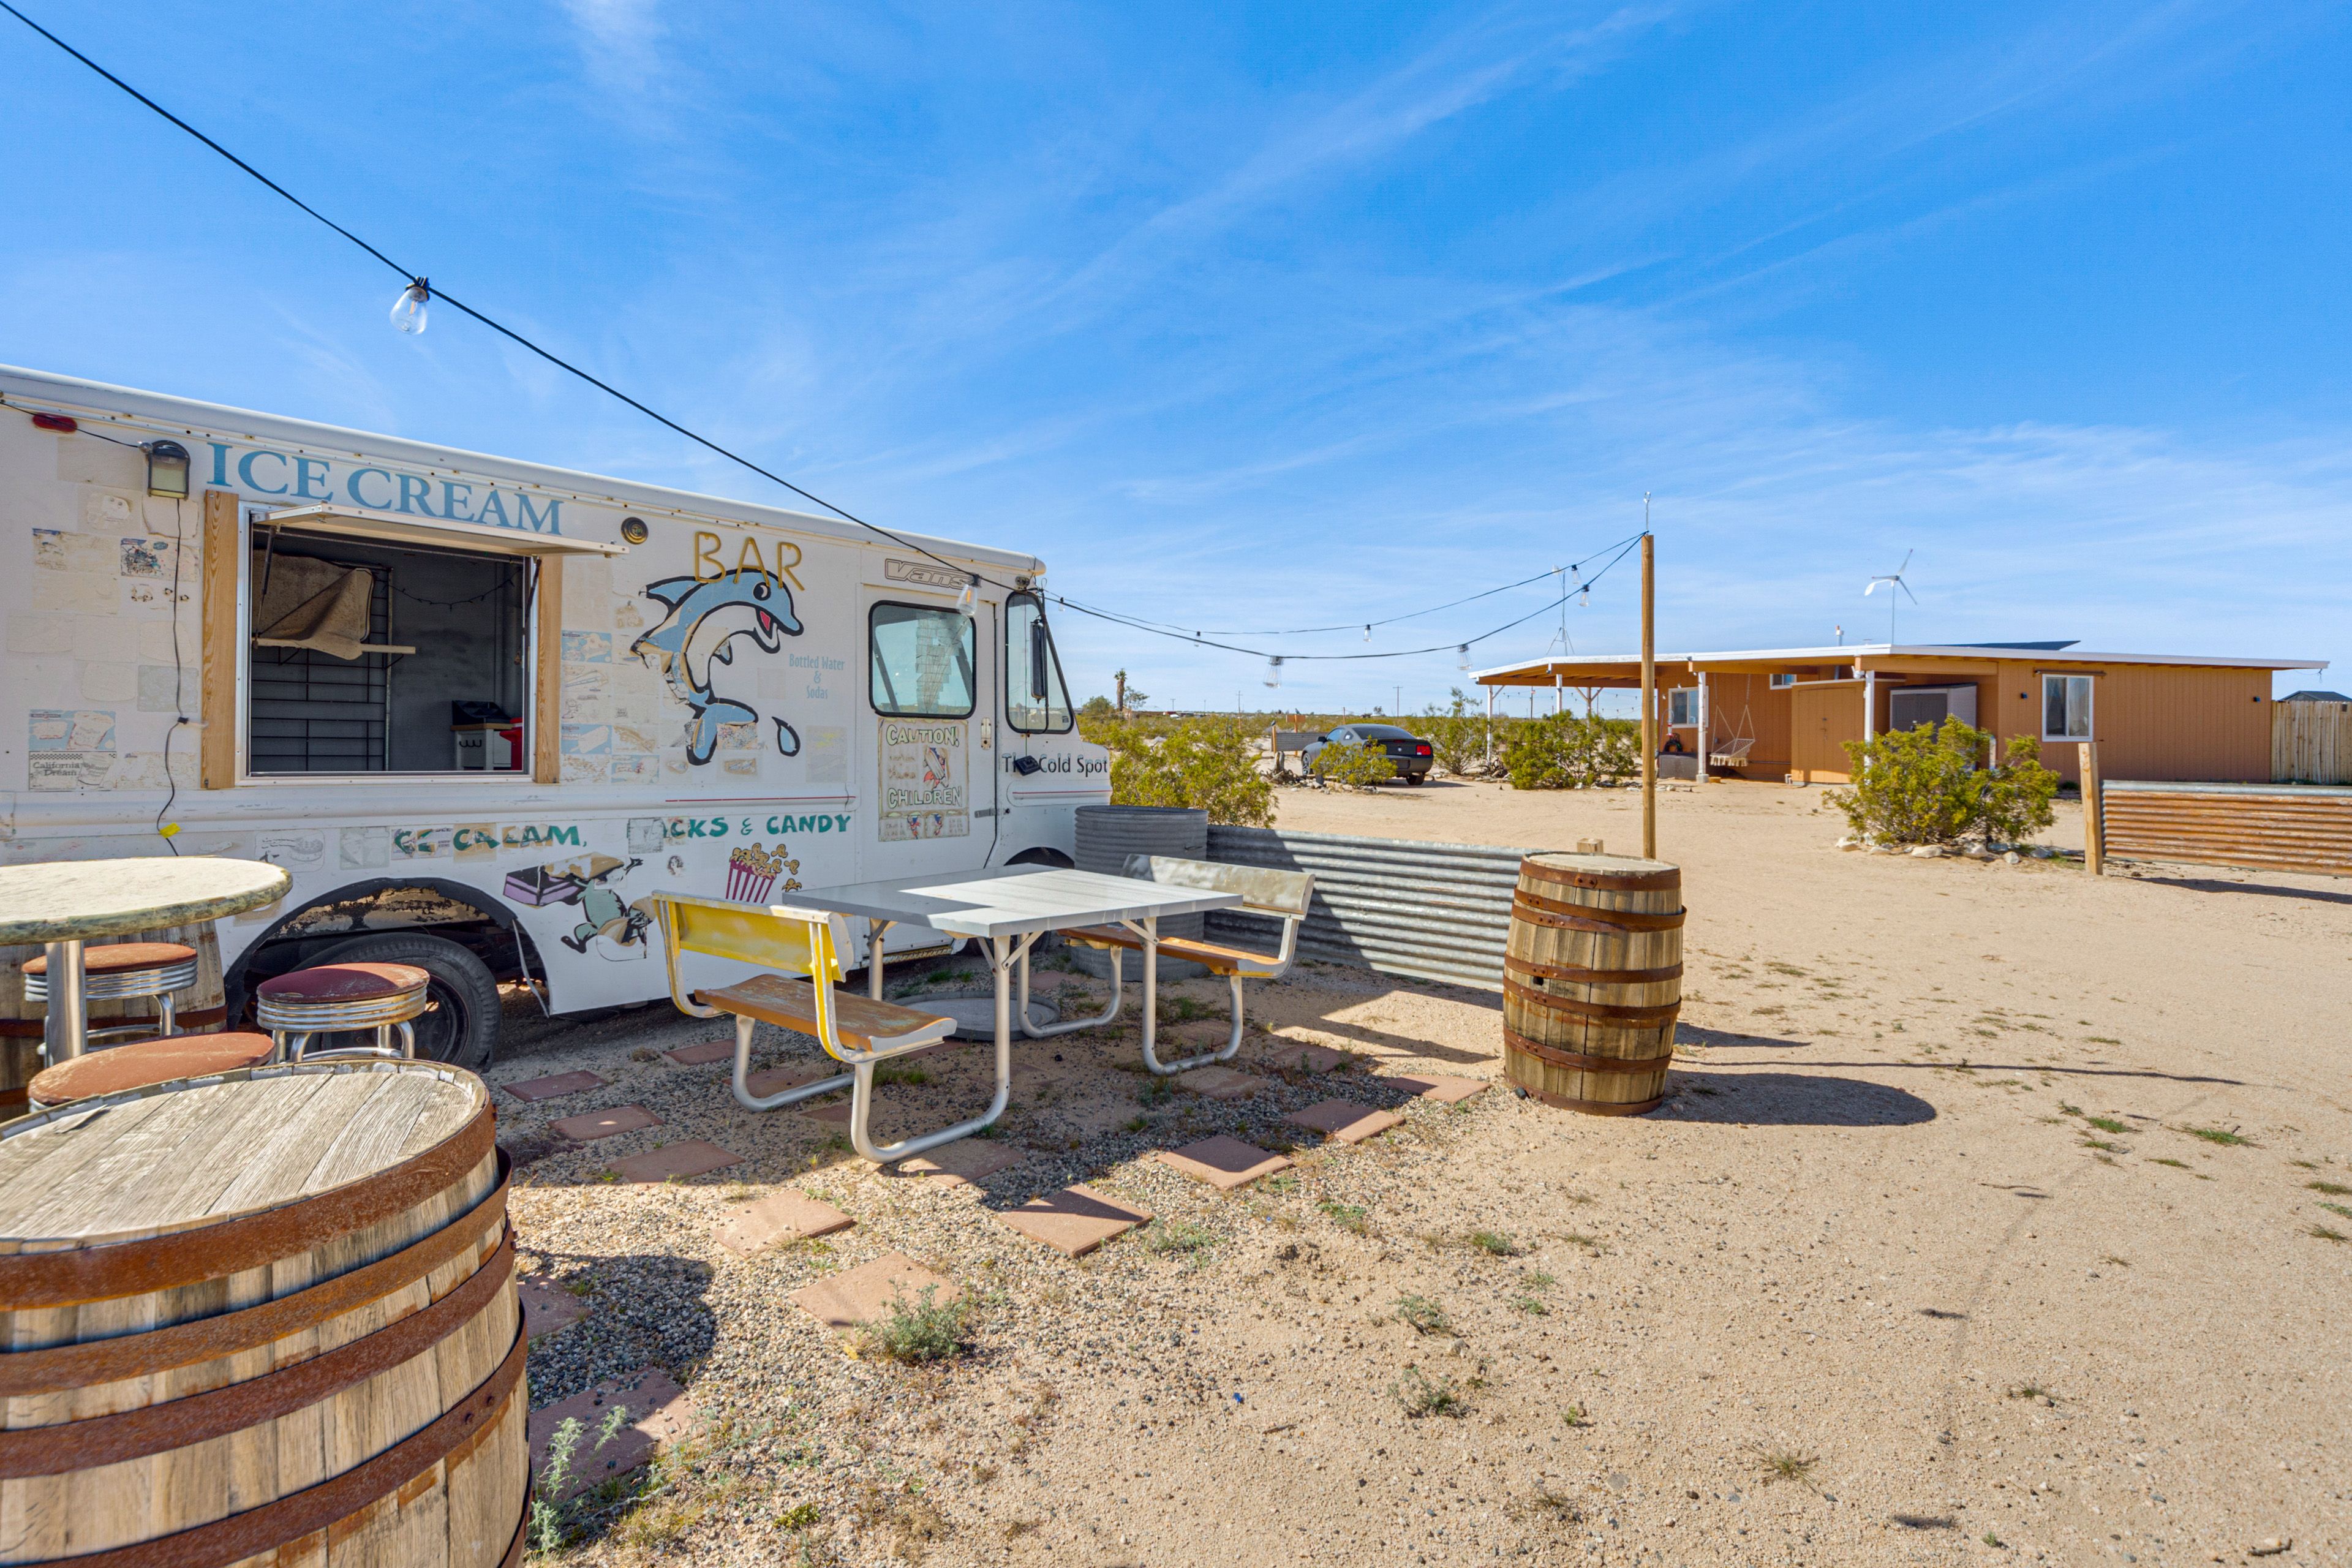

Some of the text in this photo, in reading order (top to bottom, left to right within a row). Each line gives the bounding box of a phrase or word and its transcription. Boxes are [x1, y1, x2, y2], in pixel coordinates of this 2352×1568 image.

[206, 442, 564, 535] ICE CREAM
[695, 531, 805, 591] BAR
[885, 558, 975, 590] Vans
[789, 653, 845, 670] Bottled Water
[813, 670, 822, 684] &
[806, 685, 828, 699] Sodas
[1039, 753, 1071, 773] Cold
[1077, 754, 1108, 777] Spot
[888, 785, 963, 809] CHILDREN
[740, 817, 753, 835] &
[766, 814, 851, 835] CANDY
